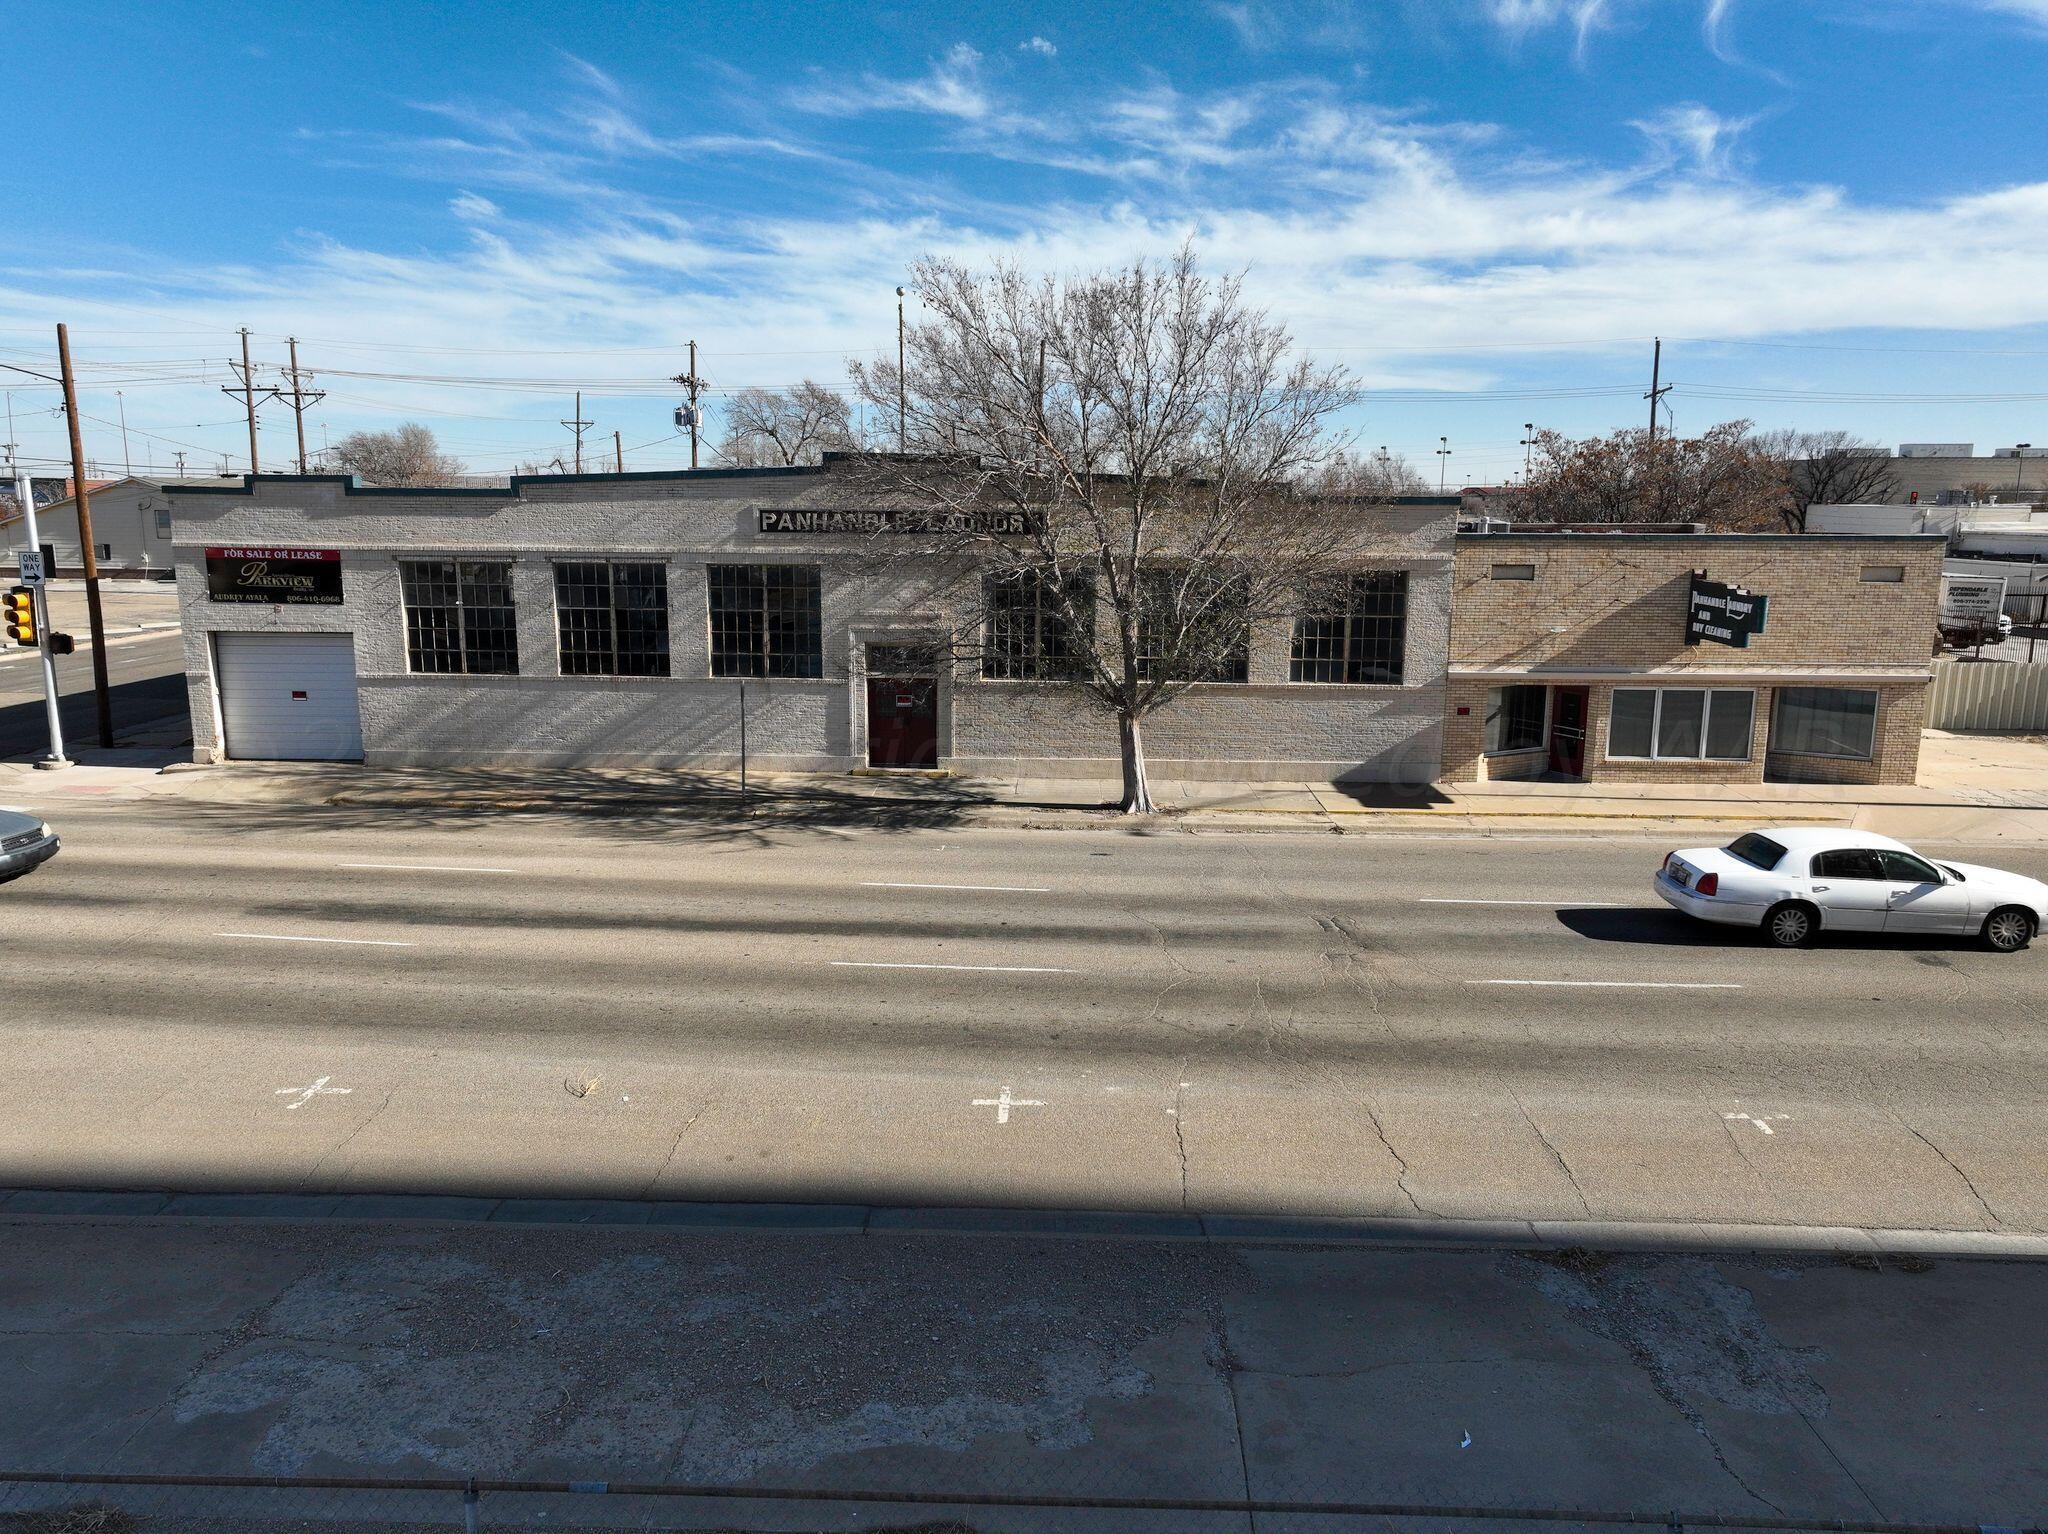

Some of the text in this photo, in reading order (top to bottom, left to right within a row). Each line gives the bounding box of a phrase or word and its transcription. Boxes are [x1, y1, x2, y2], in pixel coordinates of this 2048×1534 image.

[22, 554, 40, 563] ONE
[224, 549, 323, 560] FOR SALE OR LEASE
[22, 563, 40, 571] WAY
[1705, 625, 1732, 639] CLEANING
